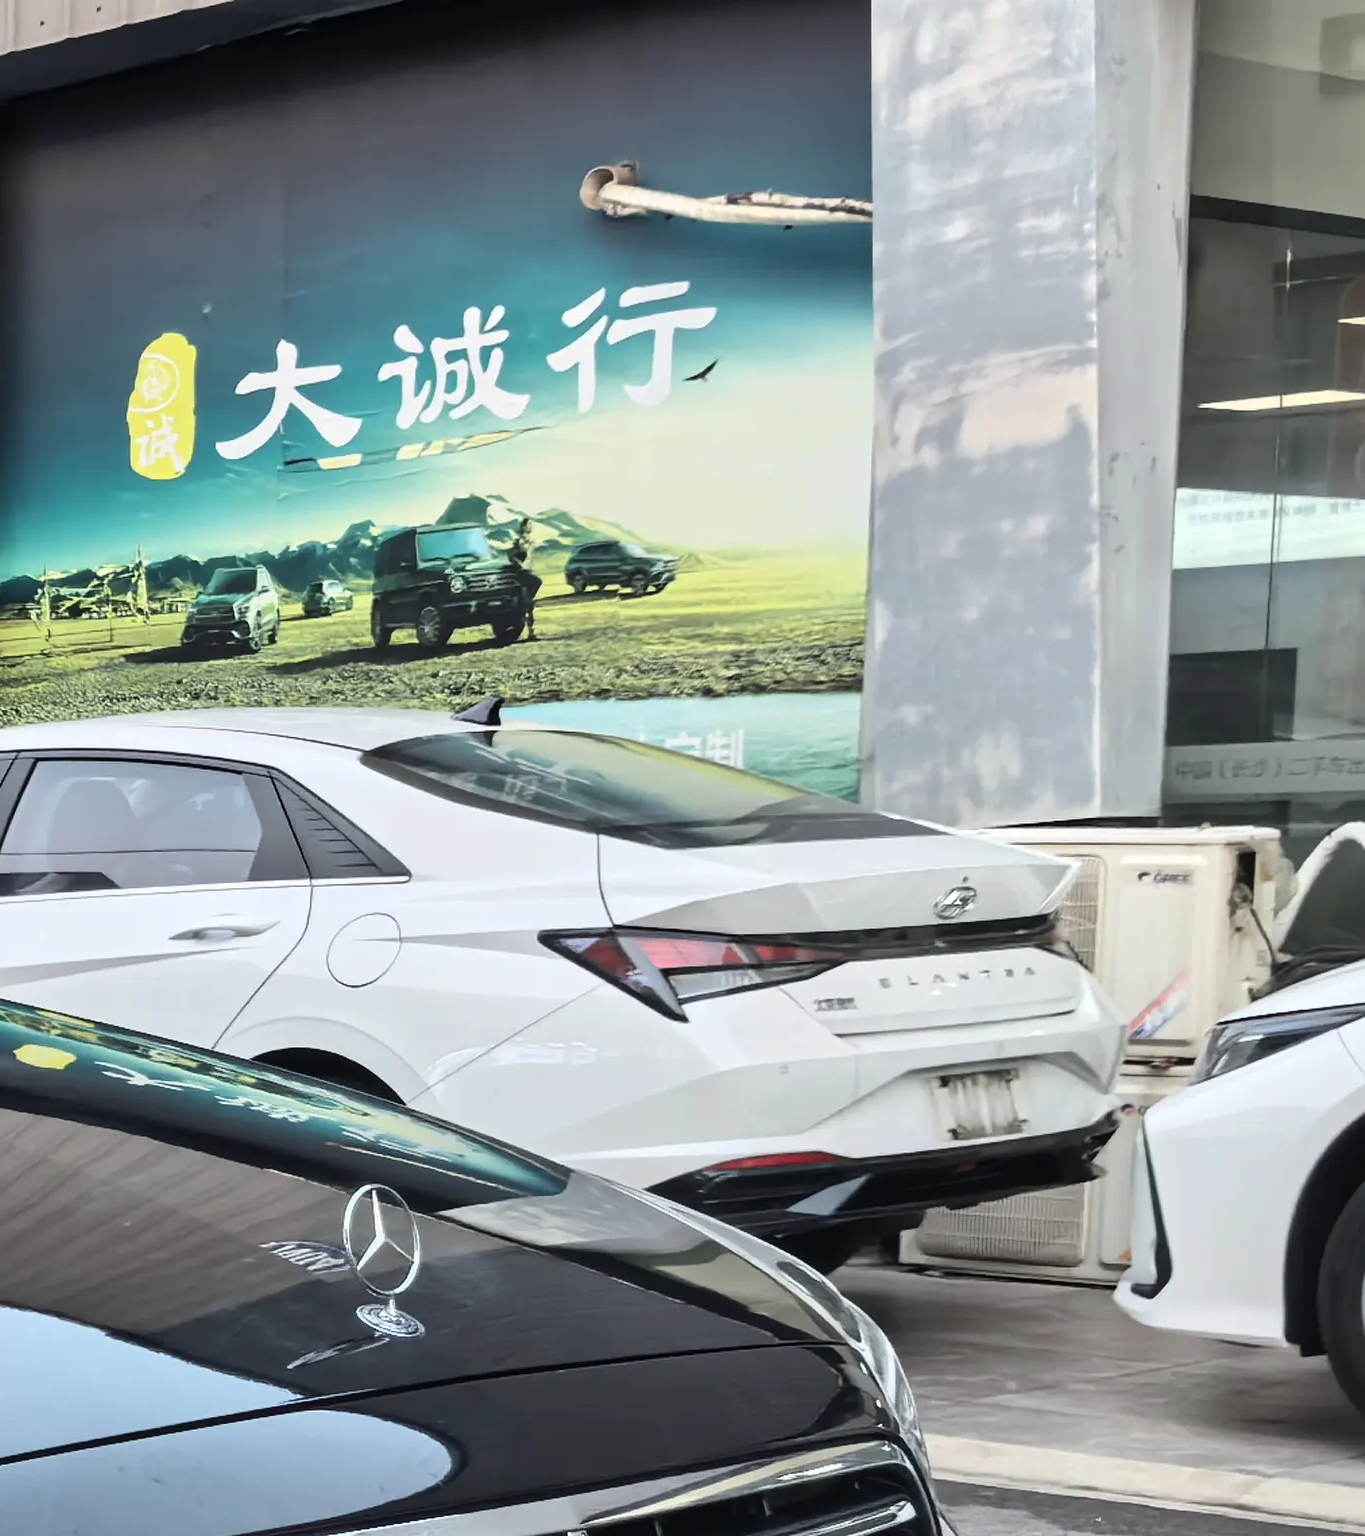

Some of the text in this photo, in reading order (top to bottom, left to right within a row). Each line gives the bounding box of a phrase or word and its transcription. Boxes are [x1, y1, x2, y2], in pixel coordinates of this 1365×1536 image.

[215, 281, 717, 460] 大诚行
[878, 967, 1036, 989] ELANTRA
